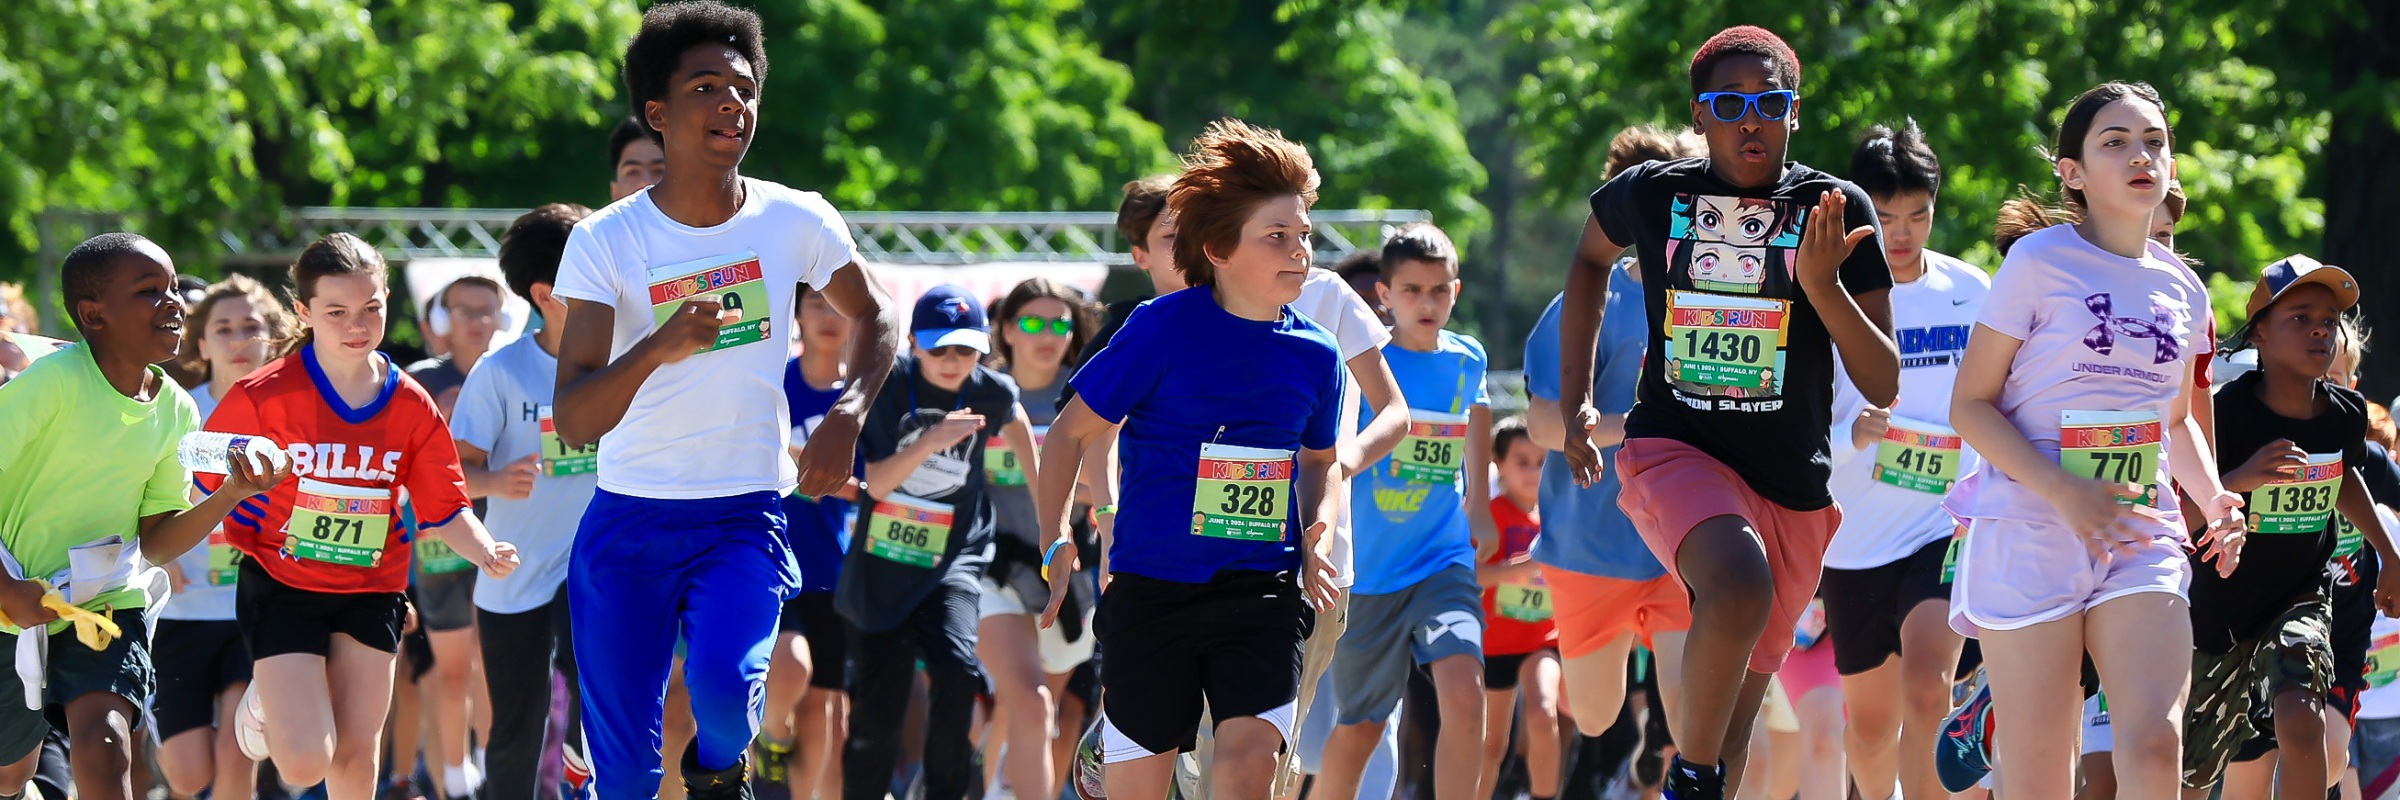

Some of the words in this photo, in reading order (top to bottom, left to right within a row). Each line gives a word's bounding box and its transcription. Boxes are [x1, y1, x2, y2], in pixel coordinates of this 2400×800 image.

[663, 275, 709, 301] KIDS
[709, 264, 750, 289] RUN
[1684, 309, 1725, 326] KIDS
[1727, 310, 1767, 328] RUN
[1685, 330, 1760, 363] 1430
[2072, 362, 2121, 376] UNDER
[2123, 367, 2172, 384] ARMOU
[1718, 400, 1783, 412] SLAYER
[2077, 427, 2123, 447] KIDS
[2125, 424, 2156, 445] RUN
[287, 442, 403, 482] BILLS
[1413, 440, 1452, 465] 536
[1896, 448, 1943, 475] 415
[1213, 462, 1255, 479] KIDS
[1257, 462, 1286, 479] RUN
[2090, 452, 2142, 483] 770
[2308, 464, 2337, 481] RUN
[306, 495, 347, 512] KIDS
[348, 499, 382, 513] RUN
[1221, 484, 1275, 517] 328
[1374, 488, 1430, 512] NIKE
[2268, 486, 2331, 512] 1383
[312, 515, 363, 544] 871
[888, 521, 929, 547] 866
[1522, 589, 1543, 609] 70
